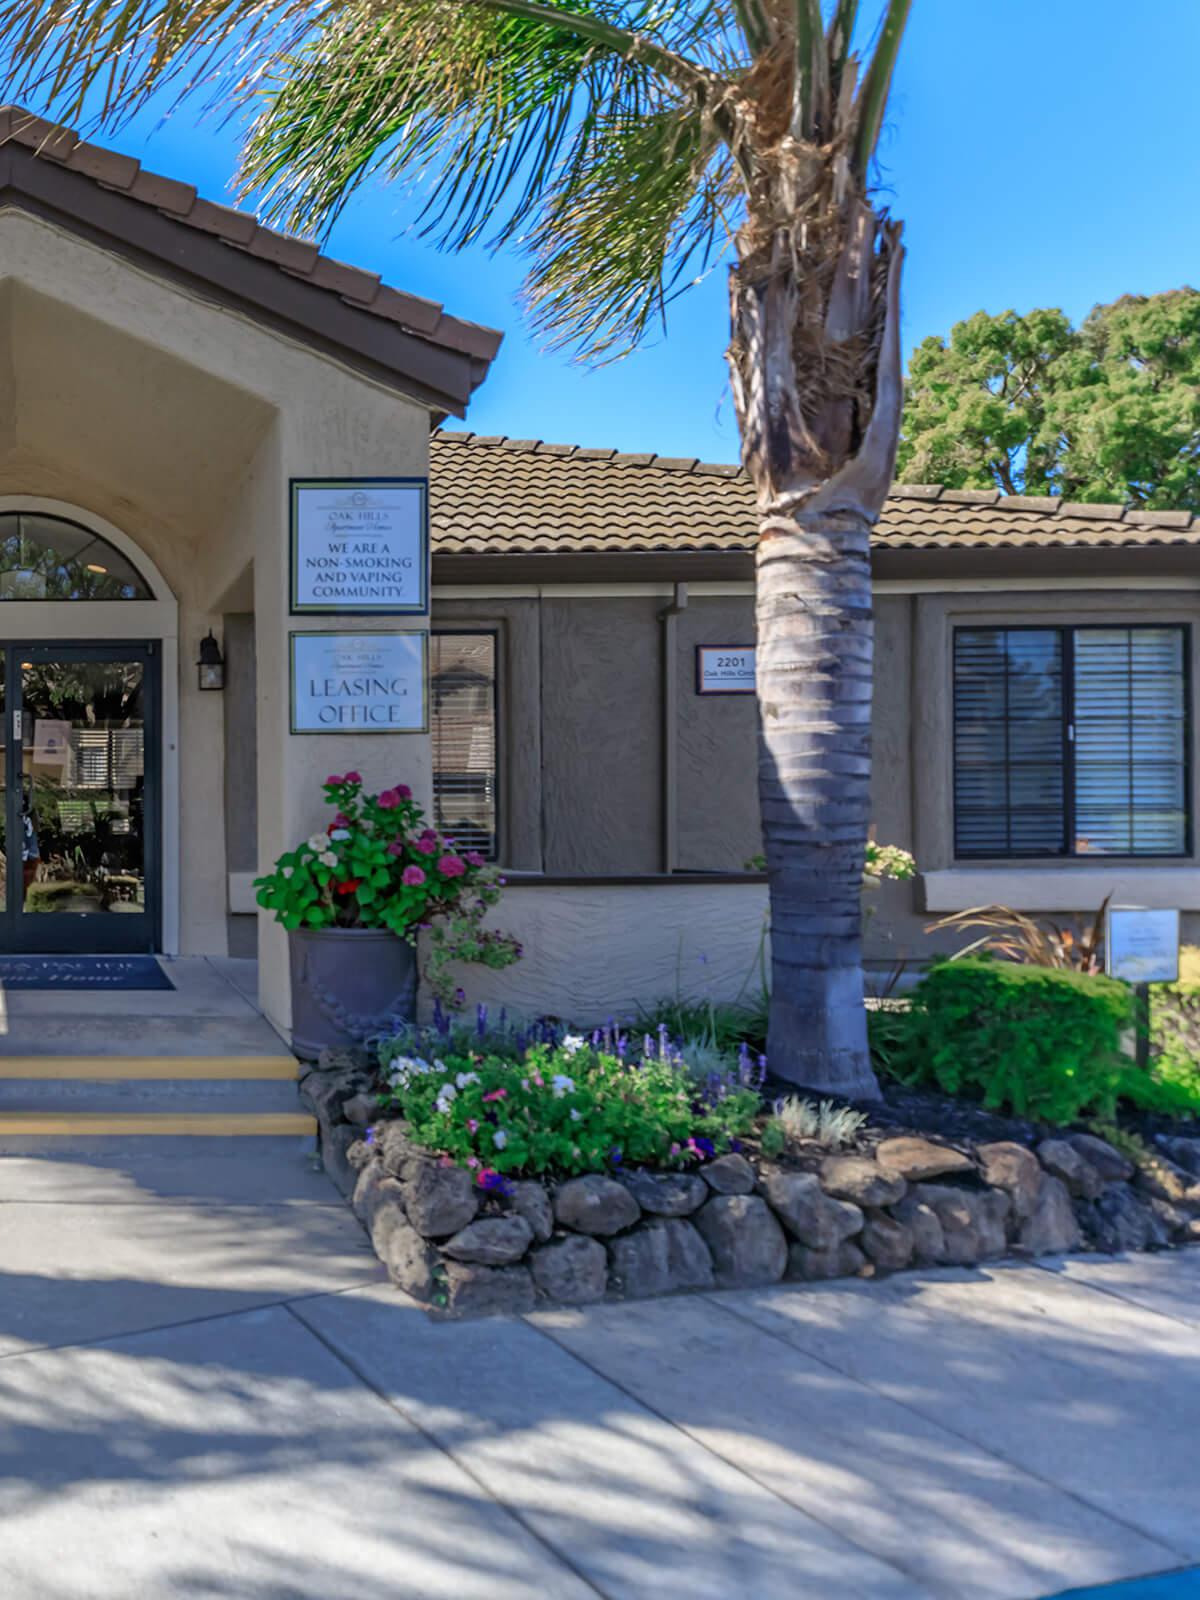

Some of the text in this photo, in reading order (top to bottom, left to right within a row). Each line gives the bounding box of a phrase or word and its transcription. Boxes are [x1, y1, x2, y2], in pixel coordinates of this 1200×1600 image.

[328, 511, 389, 521] OAK HILLS
[328, 543, 390, 554] WE ARE A
[306, 557, 412, 569] NON-SMOKING
[315, 572, 402, 583] AND VAPING
[312, 586, 402, 598] COMMUNITY
[717, 657, 745, 667] 2201
[310, 679, 408, 697] LEASING
[318, 704, 400, 723] OFFICE
